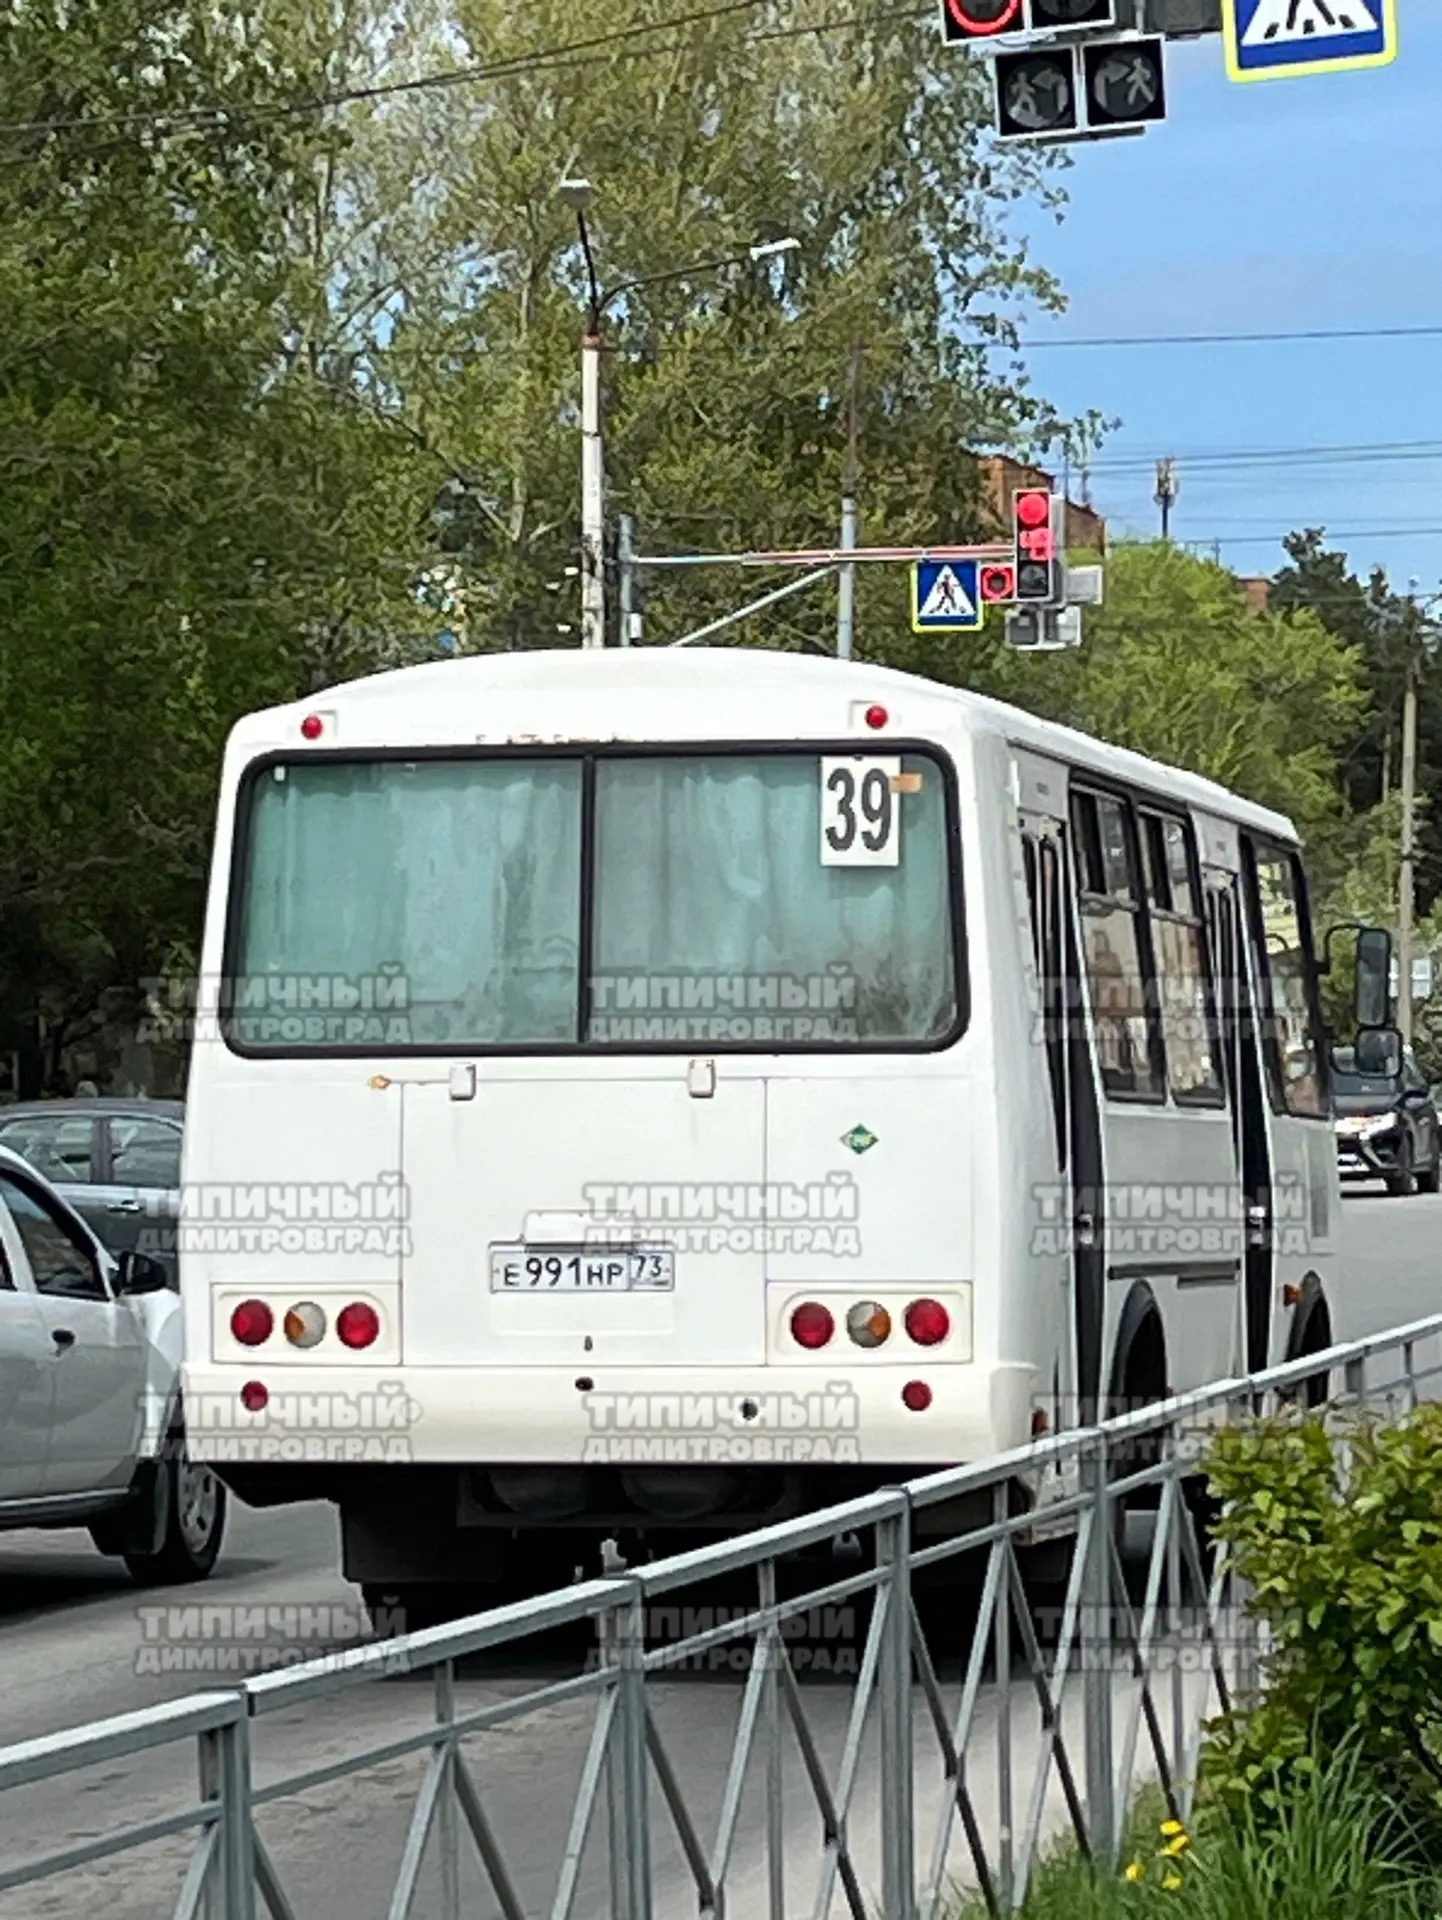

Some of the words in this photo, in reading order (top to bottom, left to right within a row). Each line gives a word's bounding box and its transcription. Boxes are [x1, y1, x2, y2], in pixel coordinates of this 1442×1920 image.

[825, 767, 892, 852] 39
[503, 1257, 624, 1287] Е991НР
[631, 1255, 663, 1279] 73
